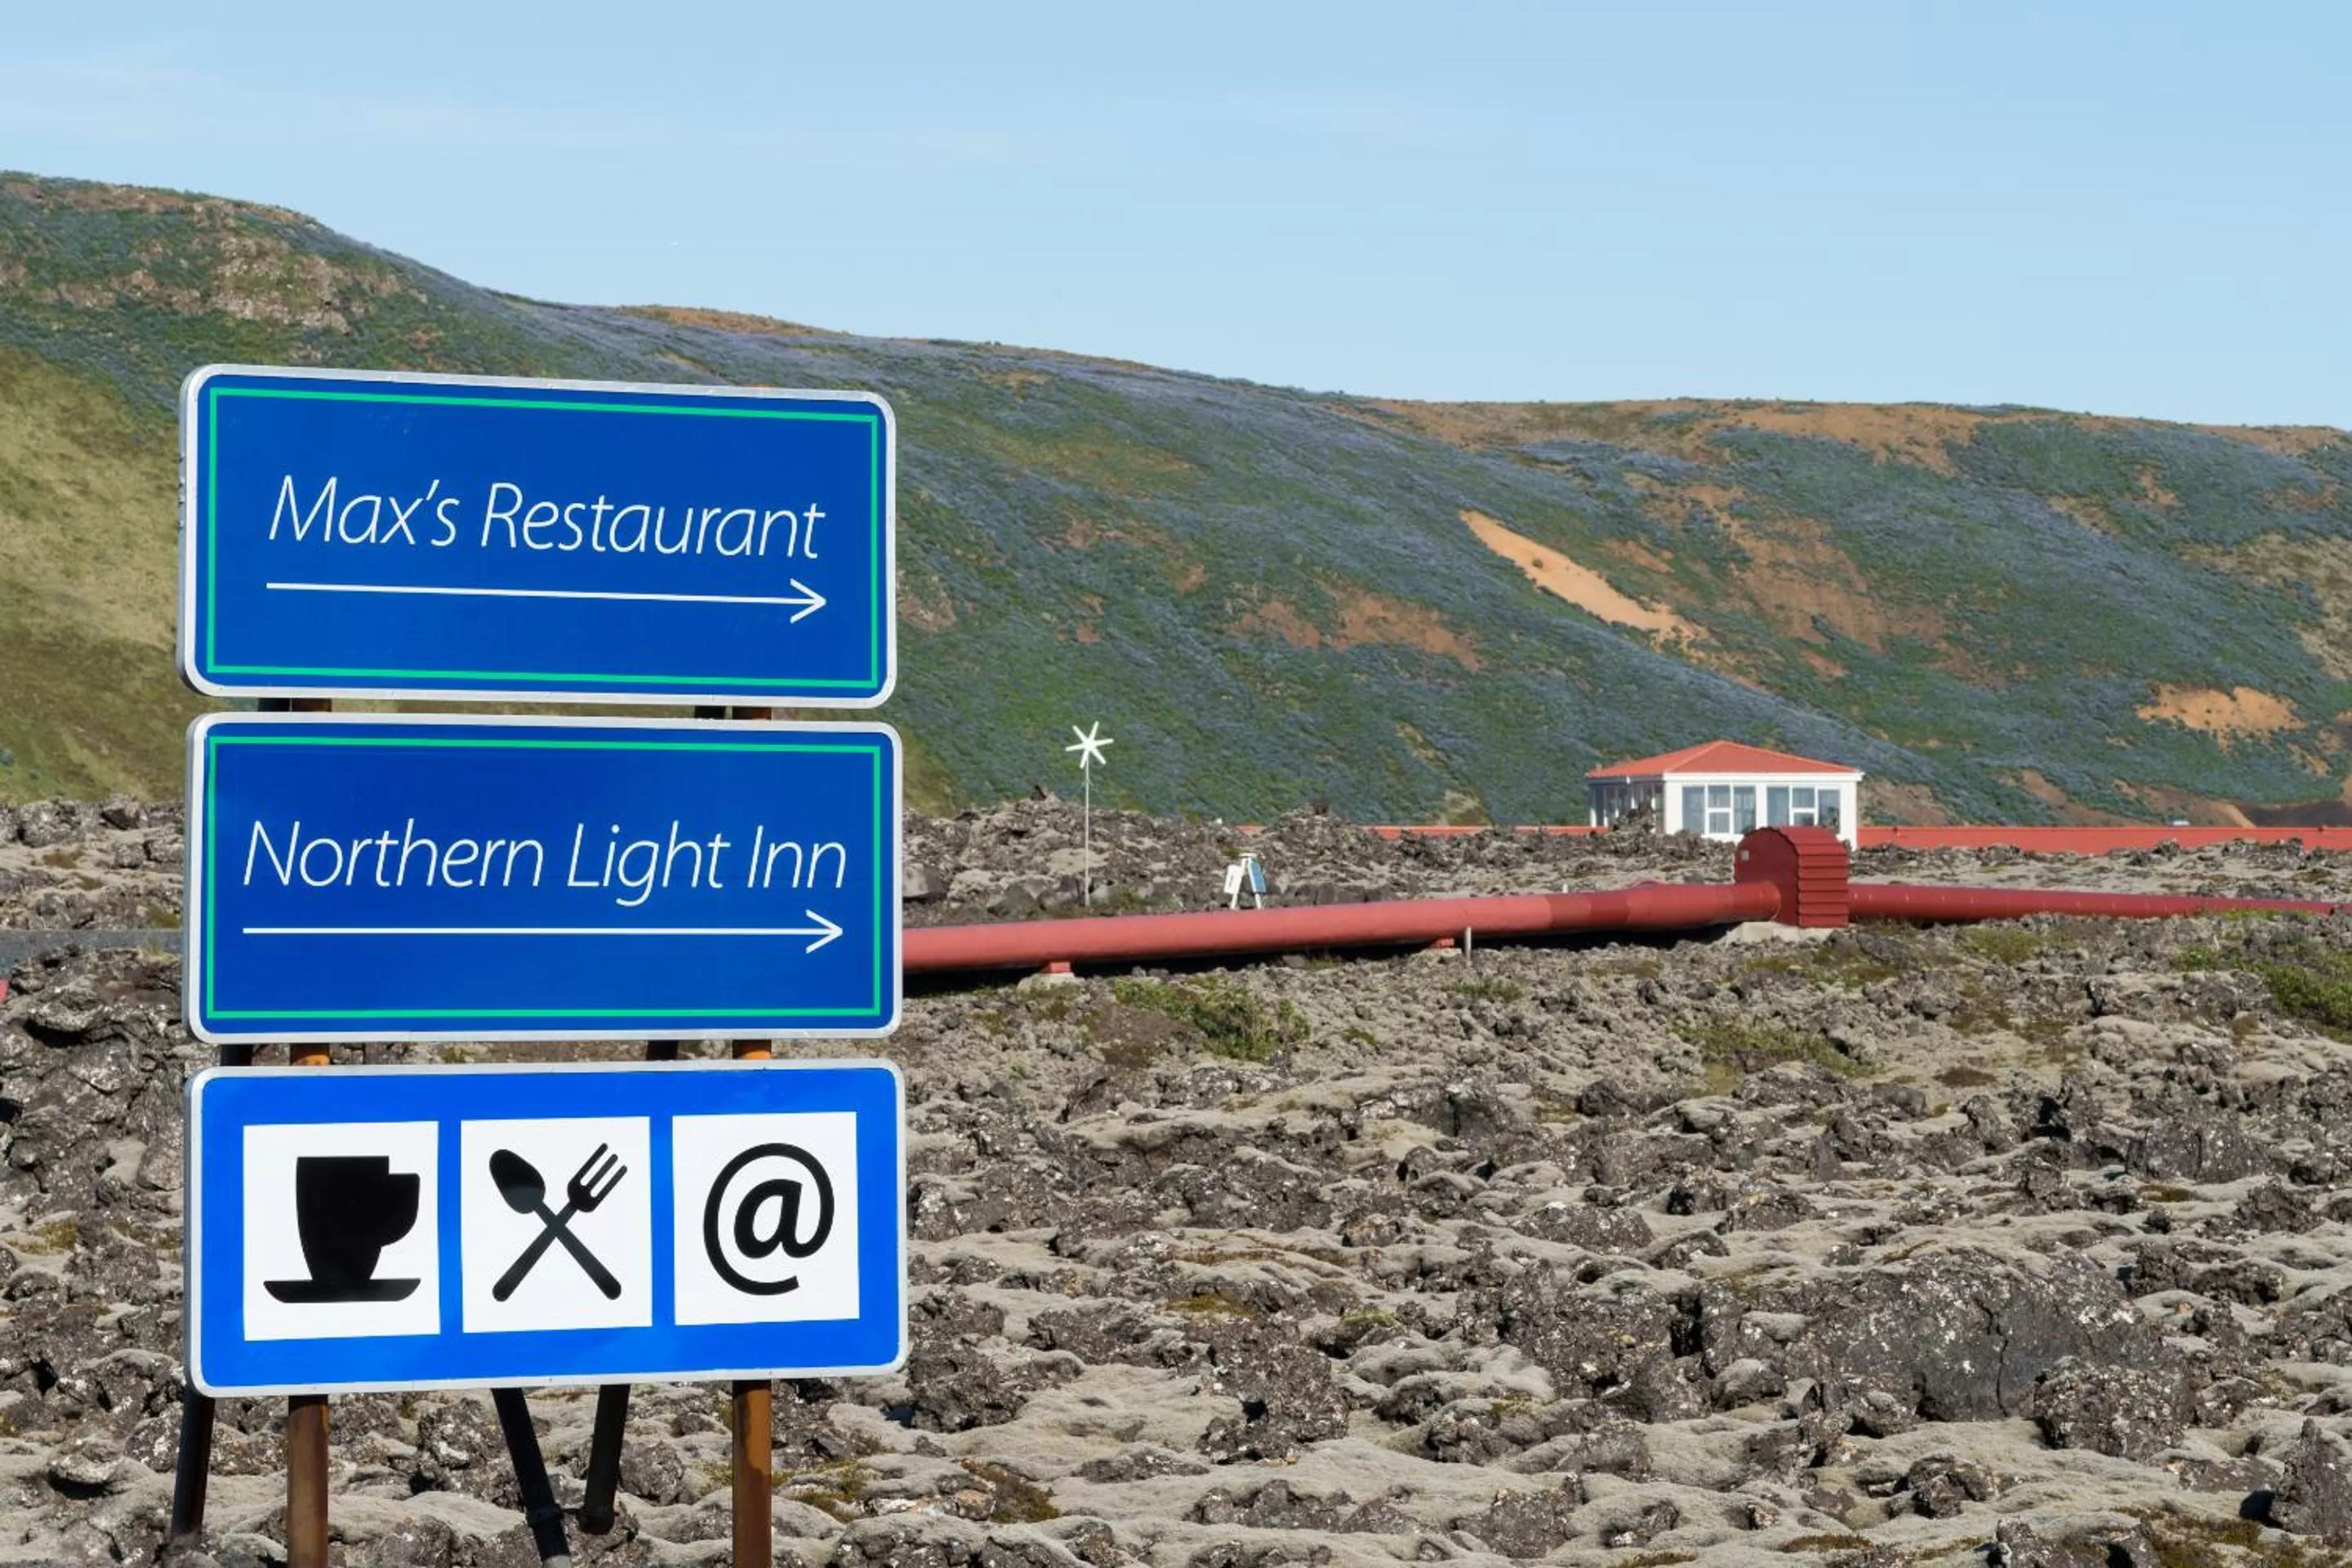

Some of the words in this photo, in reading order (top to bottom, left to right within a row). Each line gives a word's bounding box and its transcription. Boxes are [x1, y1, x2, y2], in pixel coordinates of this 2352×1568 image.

[270, 474, 459, 546] Max's
[481, 482, 826, 559] Restaurant
[243, 818, 543, 887] Northern
[568, 821, 730, 906] Light
[747, 825, 846, 888] Inn
